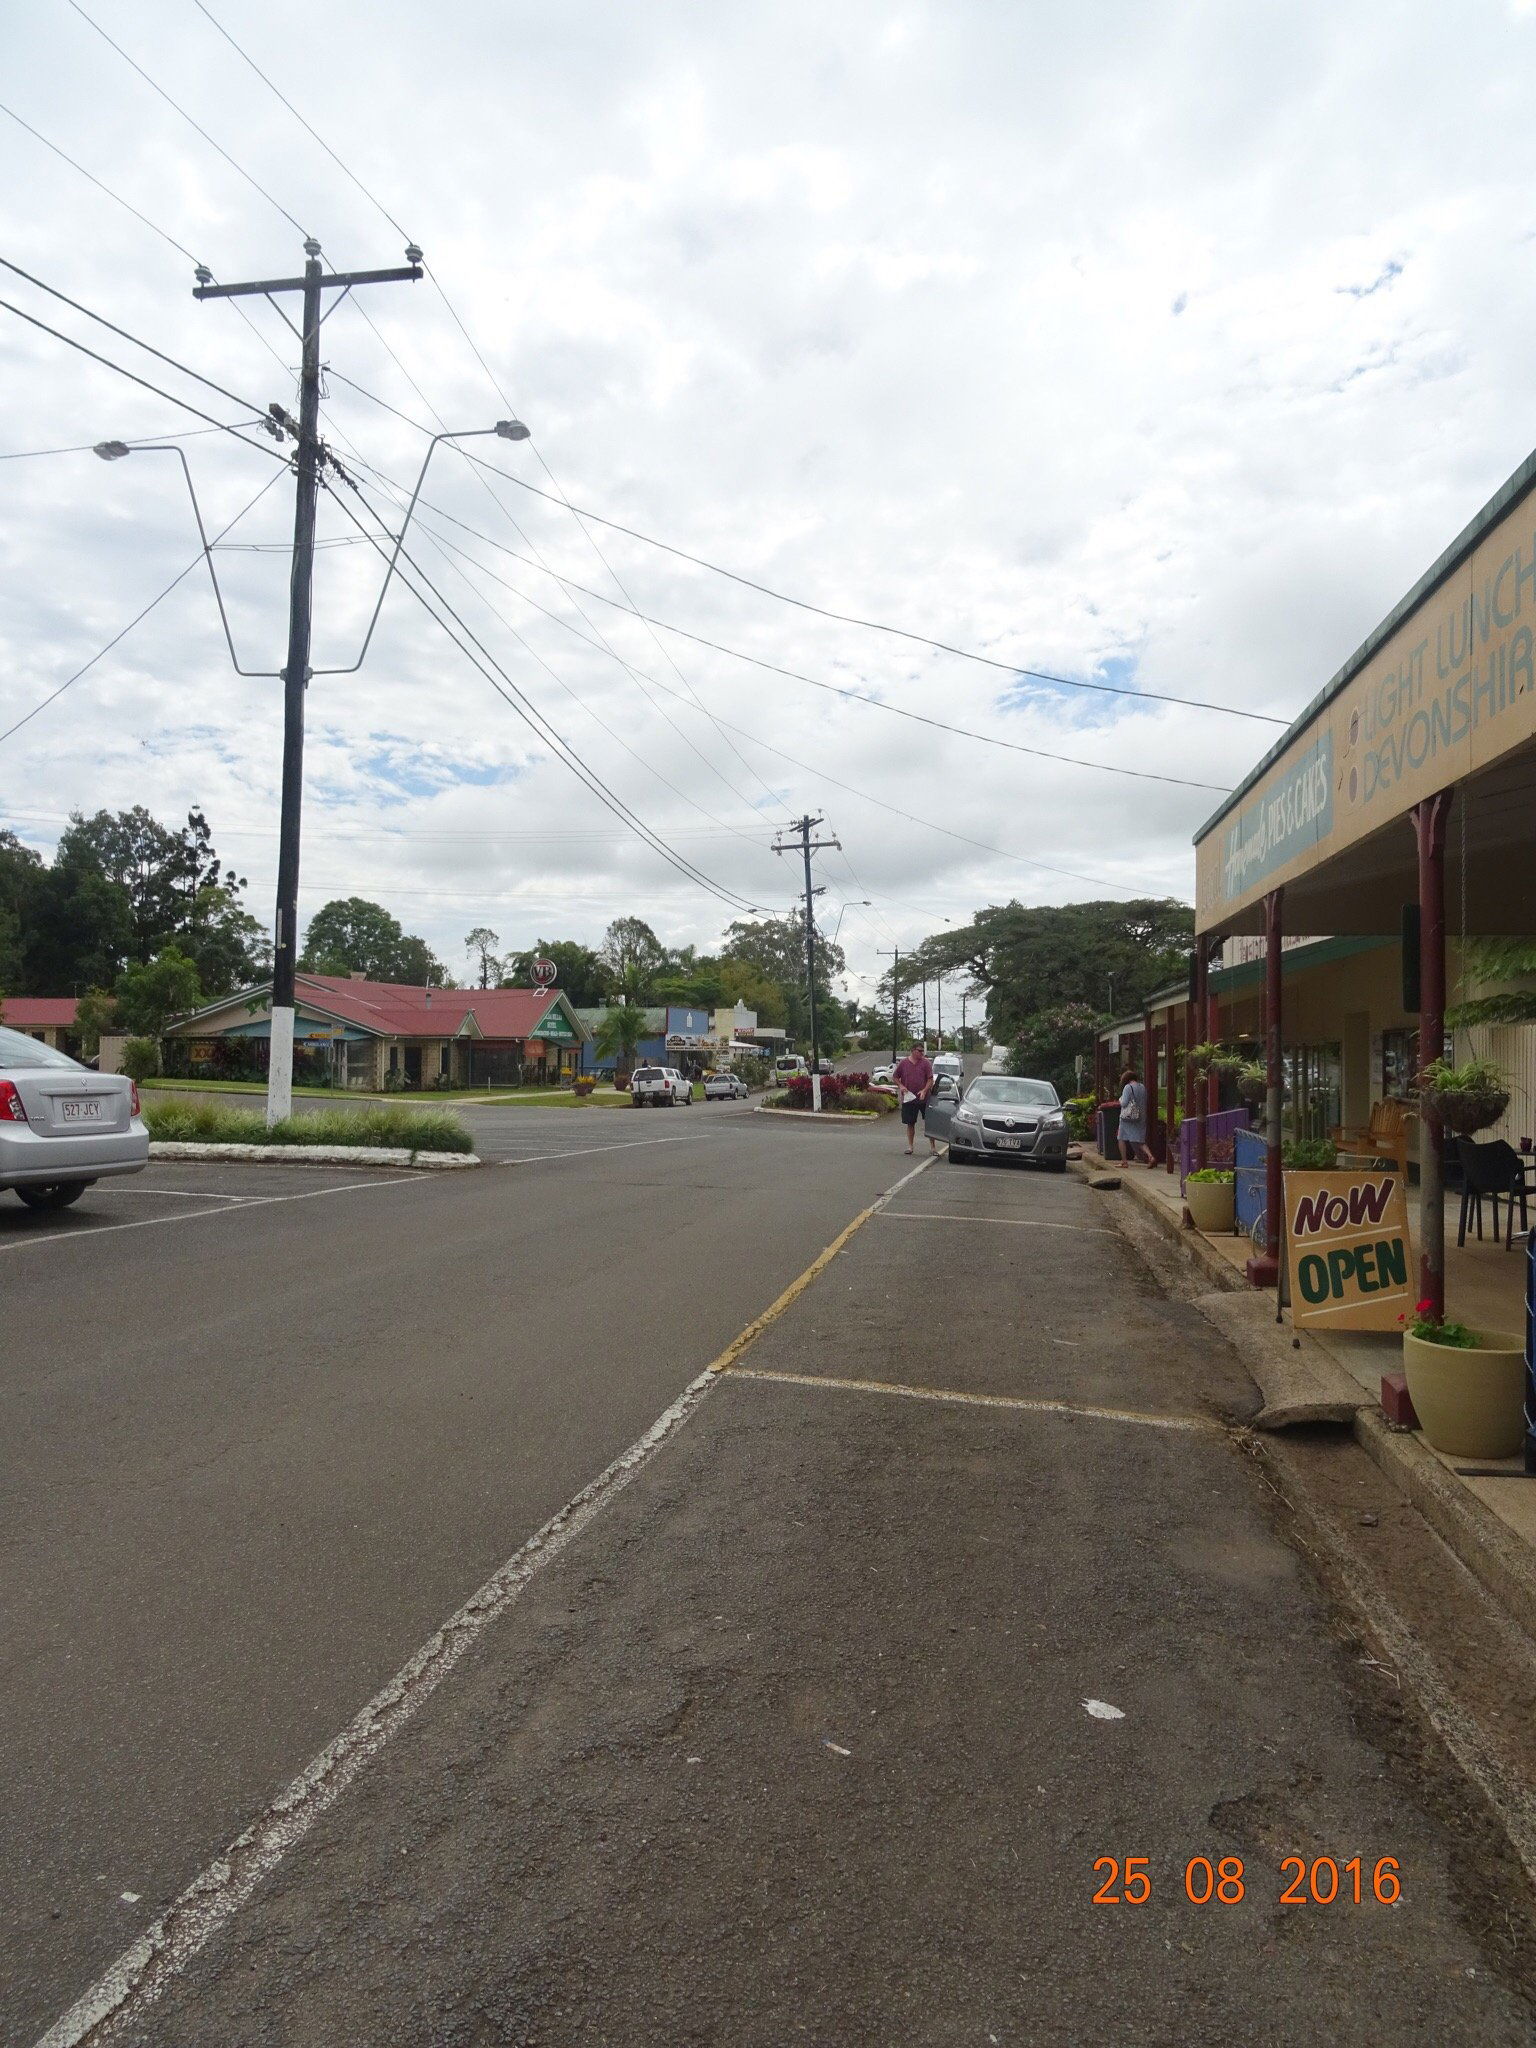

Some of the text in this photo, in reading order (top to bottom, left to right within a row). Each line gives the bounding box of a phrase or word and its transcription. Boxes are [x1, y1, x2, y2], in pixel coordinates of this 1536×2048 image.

[1364, 638, 1428, 742] LIGHT
[1268, 792, 1286, 850] PIES
[1295, 753, 1328, 831] CAKES
[1298, 1238, 1407, 1304] OPEN
